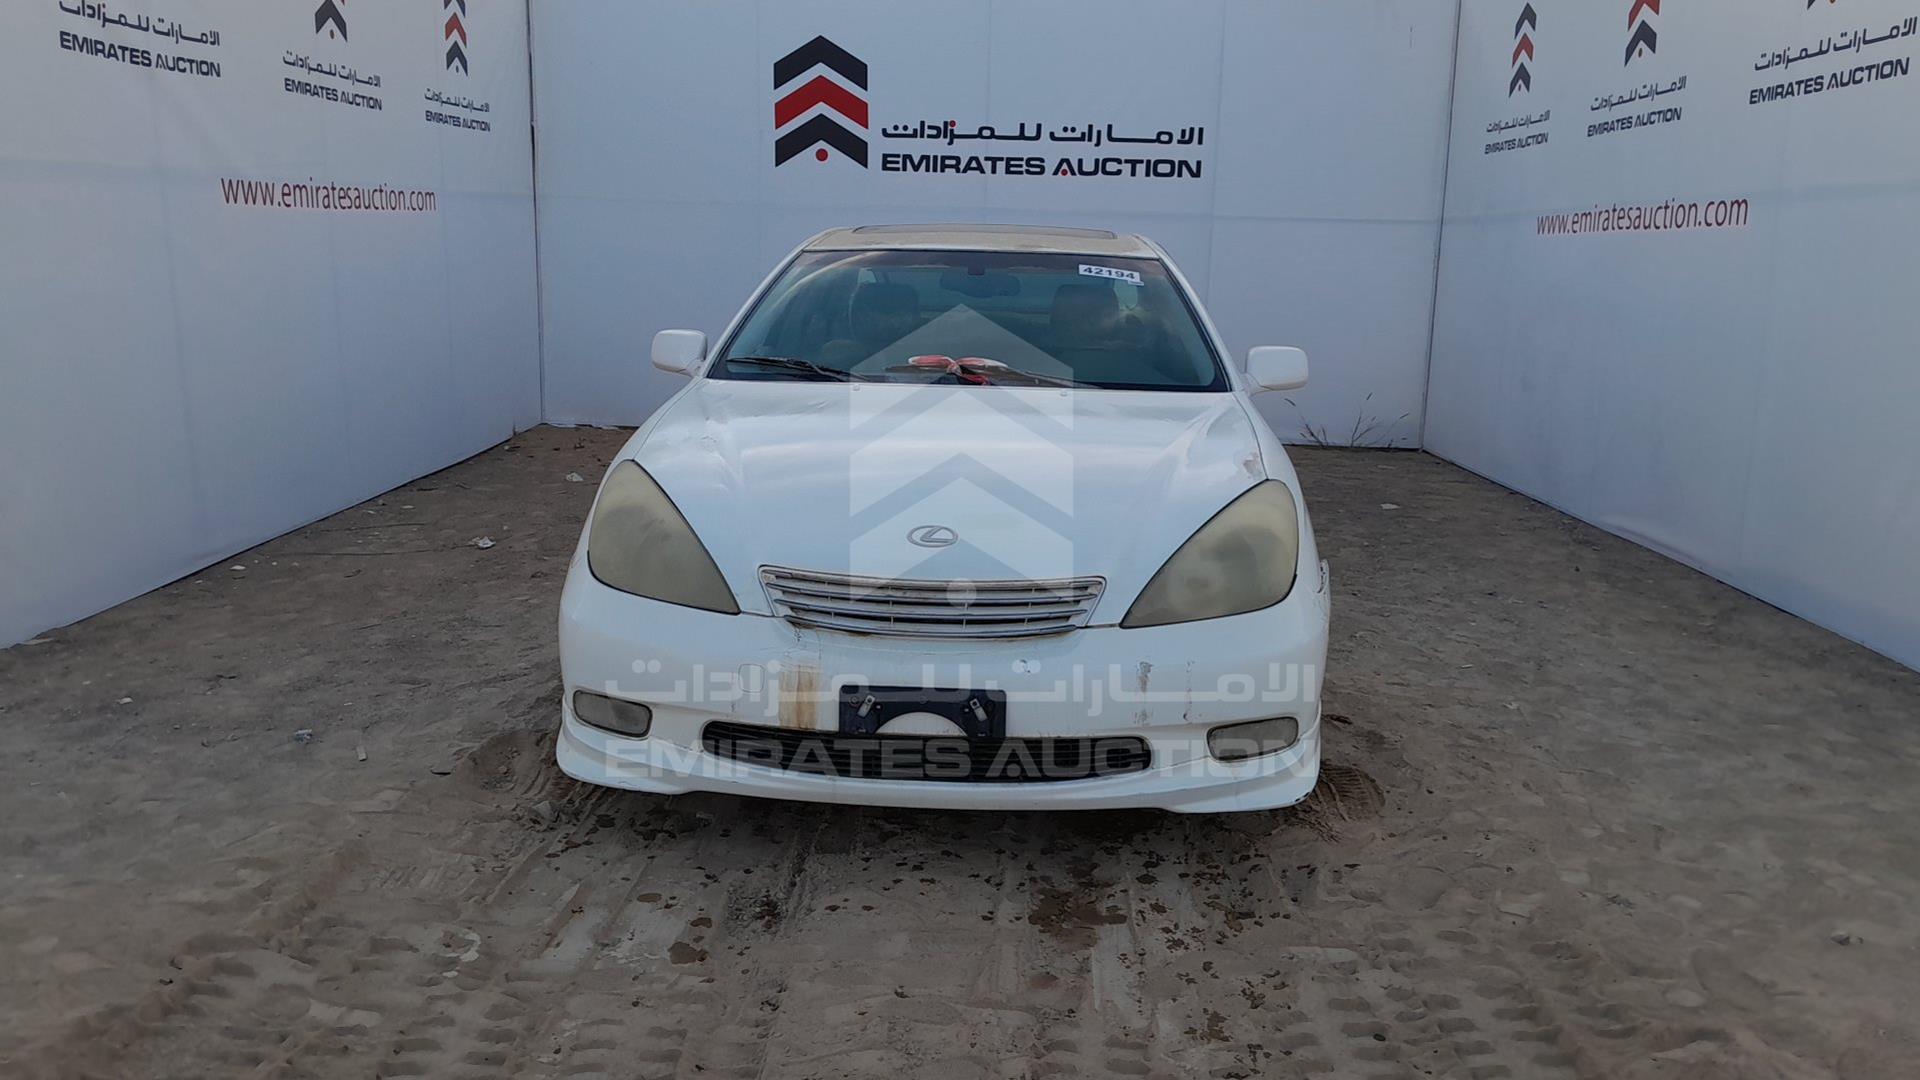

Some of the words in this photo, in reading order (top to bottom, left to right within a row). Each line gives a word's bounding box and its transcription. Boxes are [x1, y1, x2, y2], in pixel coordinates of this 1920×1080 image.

[153, 17, 220, 46] الامارات
[1833, 16, 1918, 53] الامارات
[59, 30, 152, 68] EMIRATES
[155, 53, 221, 78] AUCTION
[284, 77, 338, 102] EMIRATES
[340, 90, 382, 111] AUCTION
[1749, 75, 1824, 105] EMIRATES
[1827, 57, 1910, 91] AUCTION
[425, 110, 461, 127] EMIRATES
[462, 118, 491, 132] AUCTION
[1049, 123, 1204, 148] الامارات
[1587, 117, 1634, 137] EMIRATES
[1634, 107, 1682, 130] AUCTION
[1484, 138, 1516, 155] EMIRATES
[1517, 132, 1549, 150] AUCTION
[881, 152, 1045, 176] EMIRATES
[1052, 156, 1202, 179] AUCTION
[220, 176, 437, 212] www.emiratesauction.com
[1536, 197, 1749, 236] www.emiratesauction.com
[1083, 266, 1136, 280] 42194
